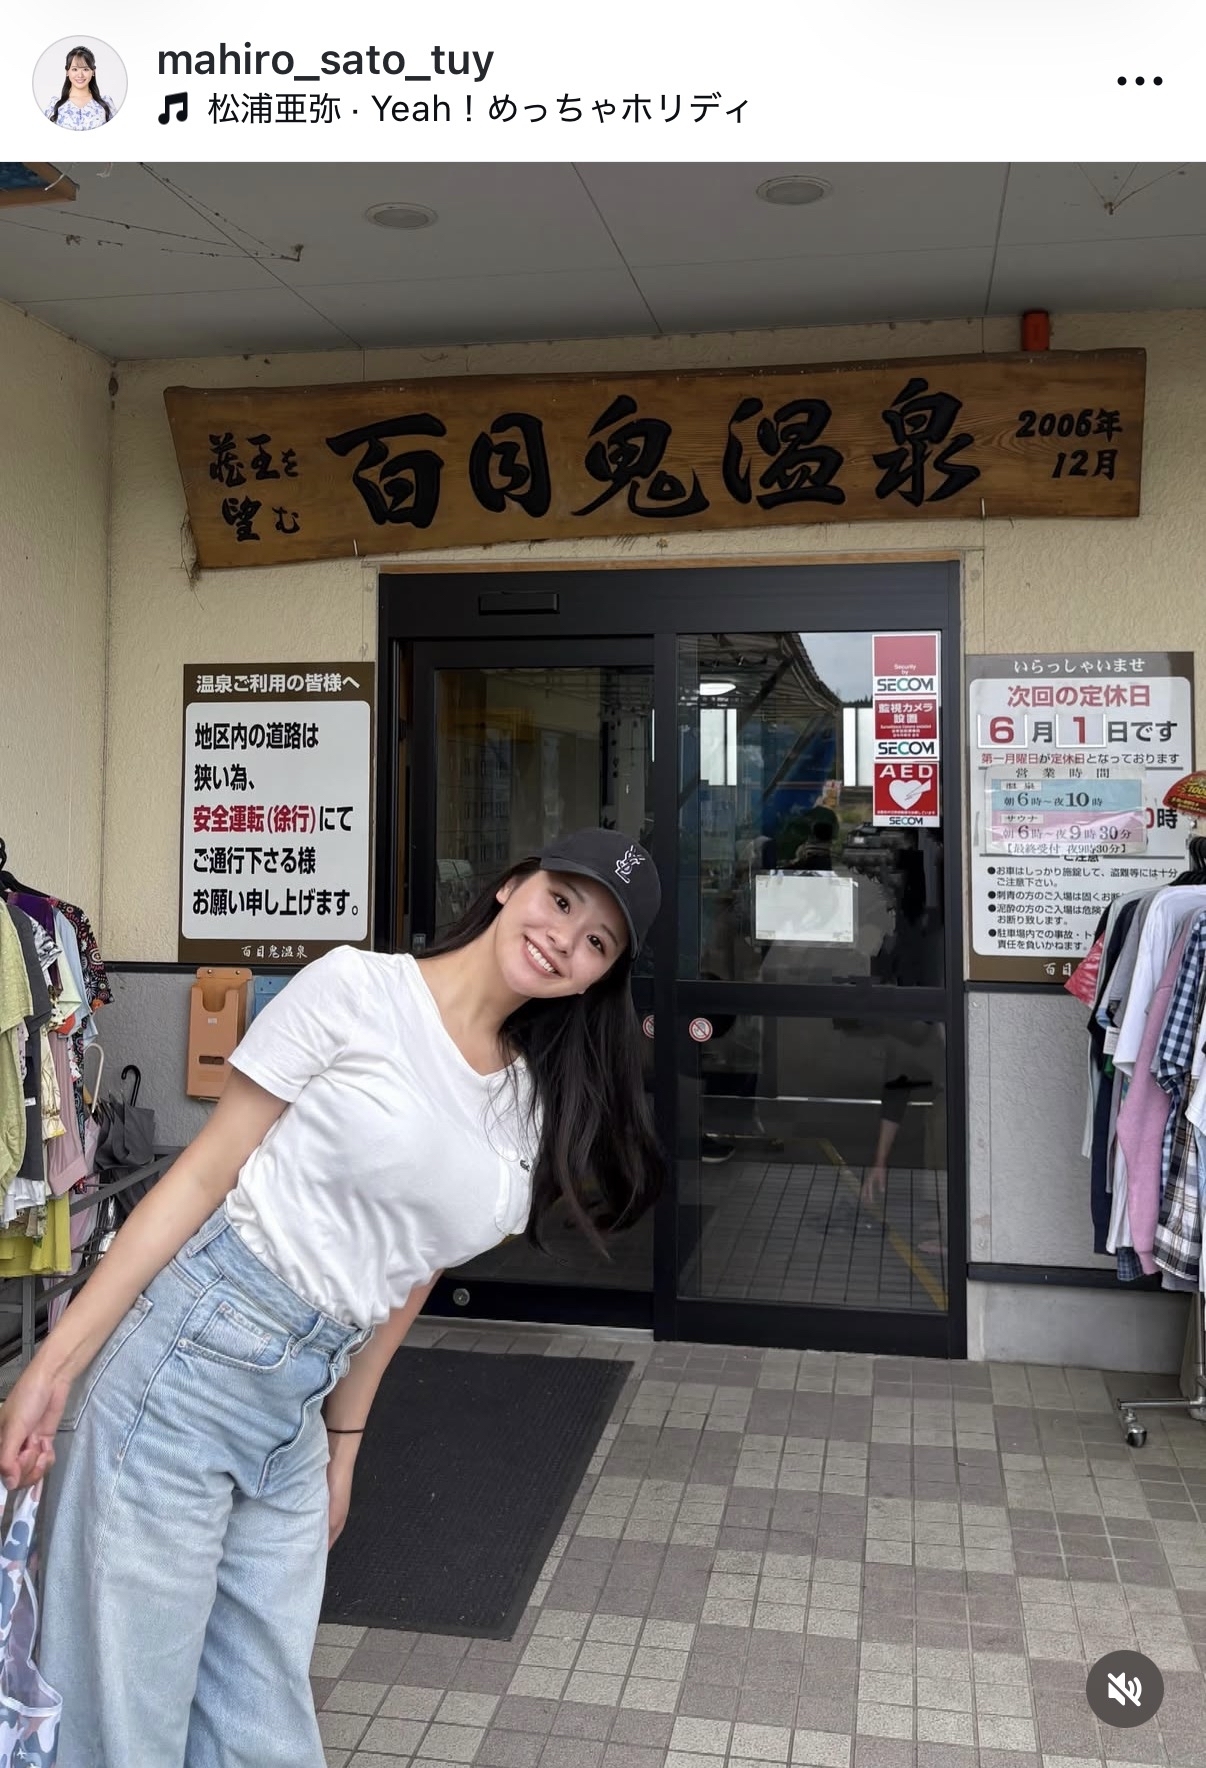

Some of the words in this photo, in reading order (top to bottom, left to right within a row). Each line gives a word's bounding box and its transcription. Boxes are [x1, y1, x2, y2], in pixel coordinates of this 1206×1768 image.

[1015, 408, 1123, 443] 2006年
[326, 377, 981, 529] 百目鬼温泉
[1051, 449, 1118, 481] 12月
[1013, 658, 1146, 674] いらっしゃいませ
[196, 674, 360, 693] 温泉ご利用の皆様へ
[877, 678, 933, 691] SECOM
[1007, 685, 1151, 708] 次回の定休日
[878, 703, 933, 713] 監視カメラ
[194, 722, 319, 750] 地区内の道路は
[878, 741, 935, 755] SECOM
[981, 753, 1180, 765] 第一月曜日が定休日となっております
[194, 764, 255, 791] 狭い為、
[879, 765, 933, 778] AED
[1015, 768, 1110, 779] 営業時間
[193, 804, 354, 833] 安全運転(徐行)にて
[889, 817, 923, 825] SECOM
[193, 846, 316, 874] ご通行下さる様
[996, 878, 1058, 887] ご注意下さい。
[192, 888, 359, 916] お願い申し上げます。
[996, 891, 1125, 901] 刺青の方のご入場は固くお断
[996, 904, 1106, 915] 泥酔の方のご入場は危険
[997, 915, 1068, 925] お断り致します。
[997, 928, 1097, 940] 駐車場内での事故・ト
[997, 940, 1088, 951] 責任を負いかねます。
